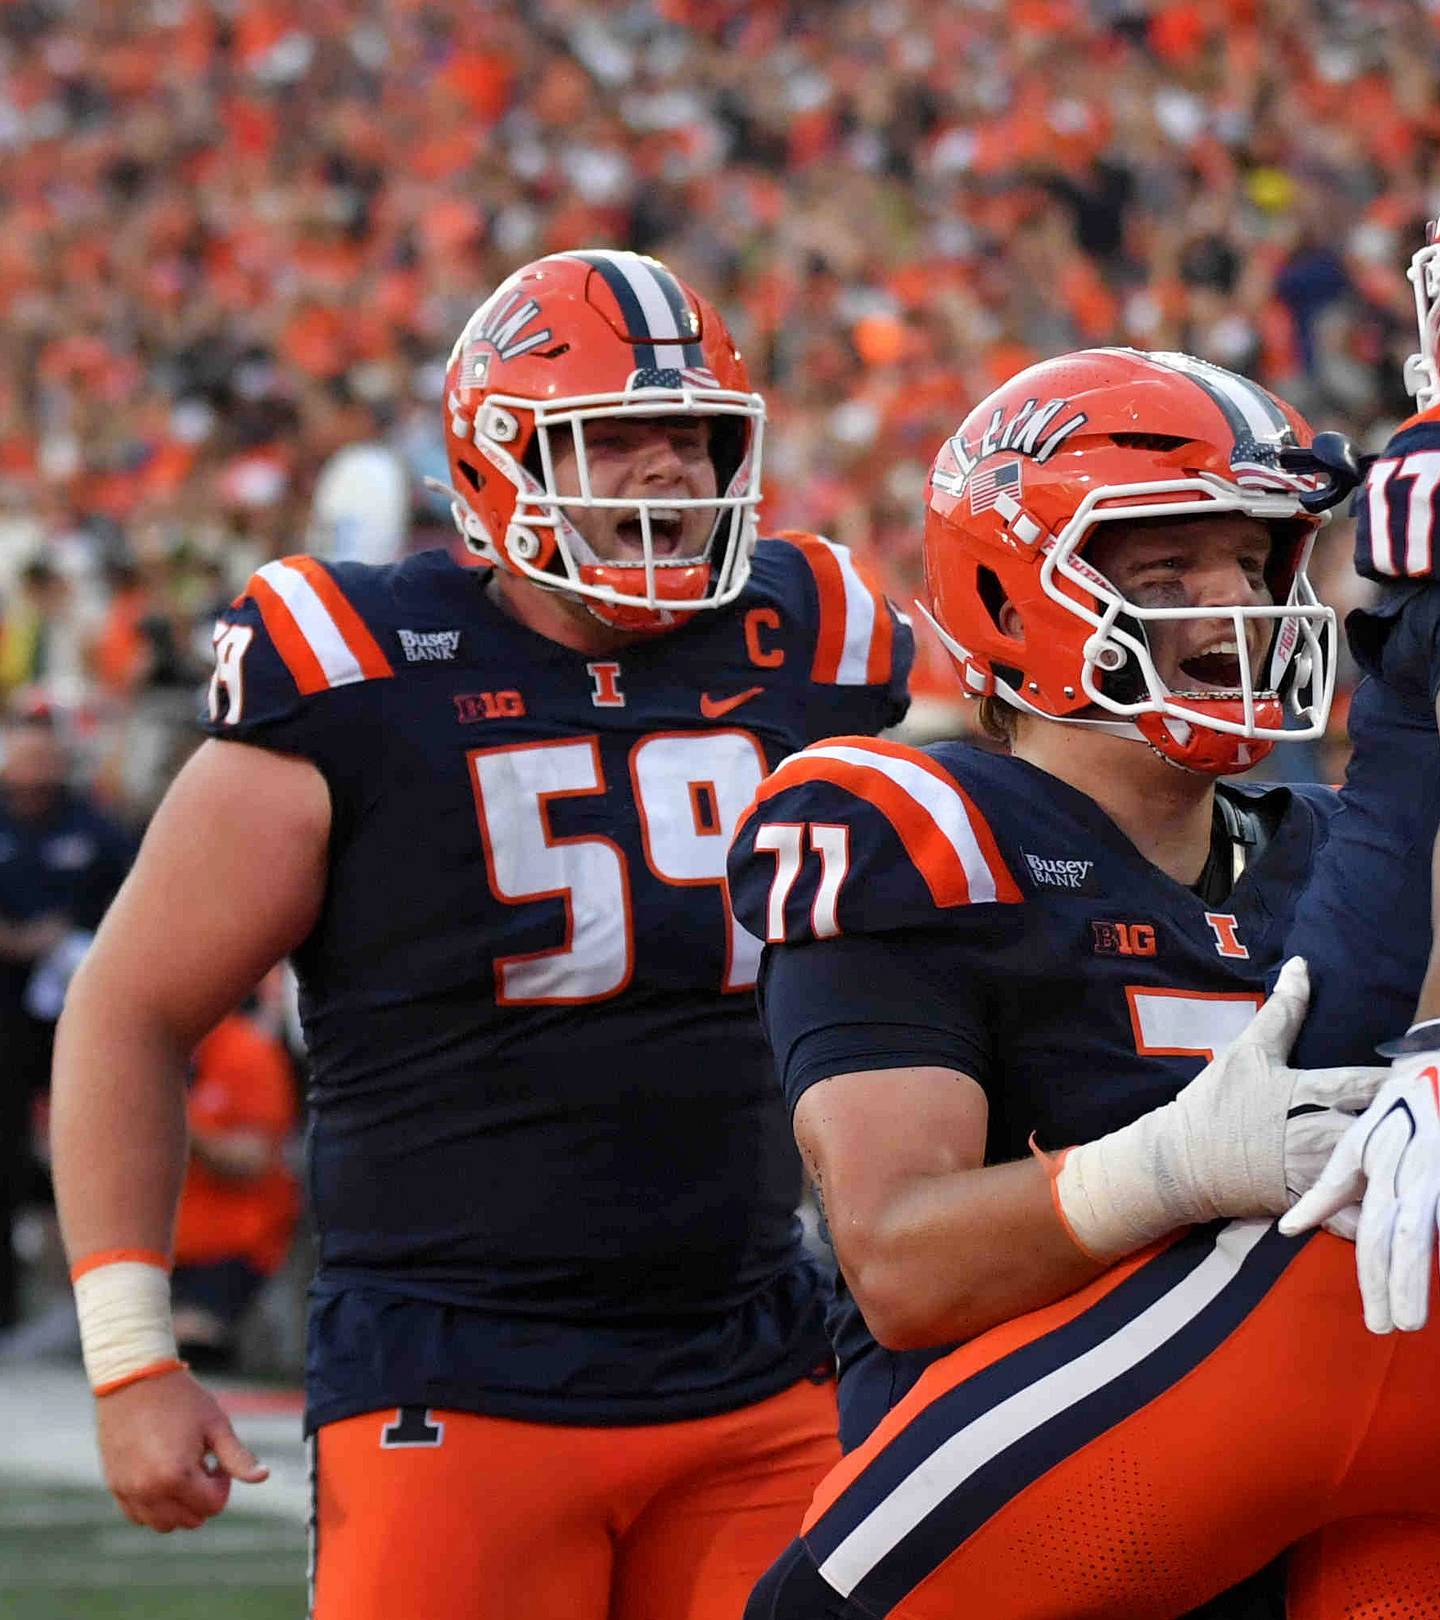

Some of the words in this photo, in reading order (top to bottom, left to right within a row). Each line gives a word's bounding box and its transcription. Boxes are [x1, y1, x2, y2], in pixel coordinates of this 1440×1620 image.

[396, 629, 461, 651] Busey
[403, 646, 456, 662] BANK
[743, 608, 785, 668] C
[586, 662, 626, 708] I
[465, 727, 770, 1006] 59
[1023, 853, 1090, 880] Busey
[1033, 869, 1082, 888] BANK
[1203, 911, 1250, 960] I
